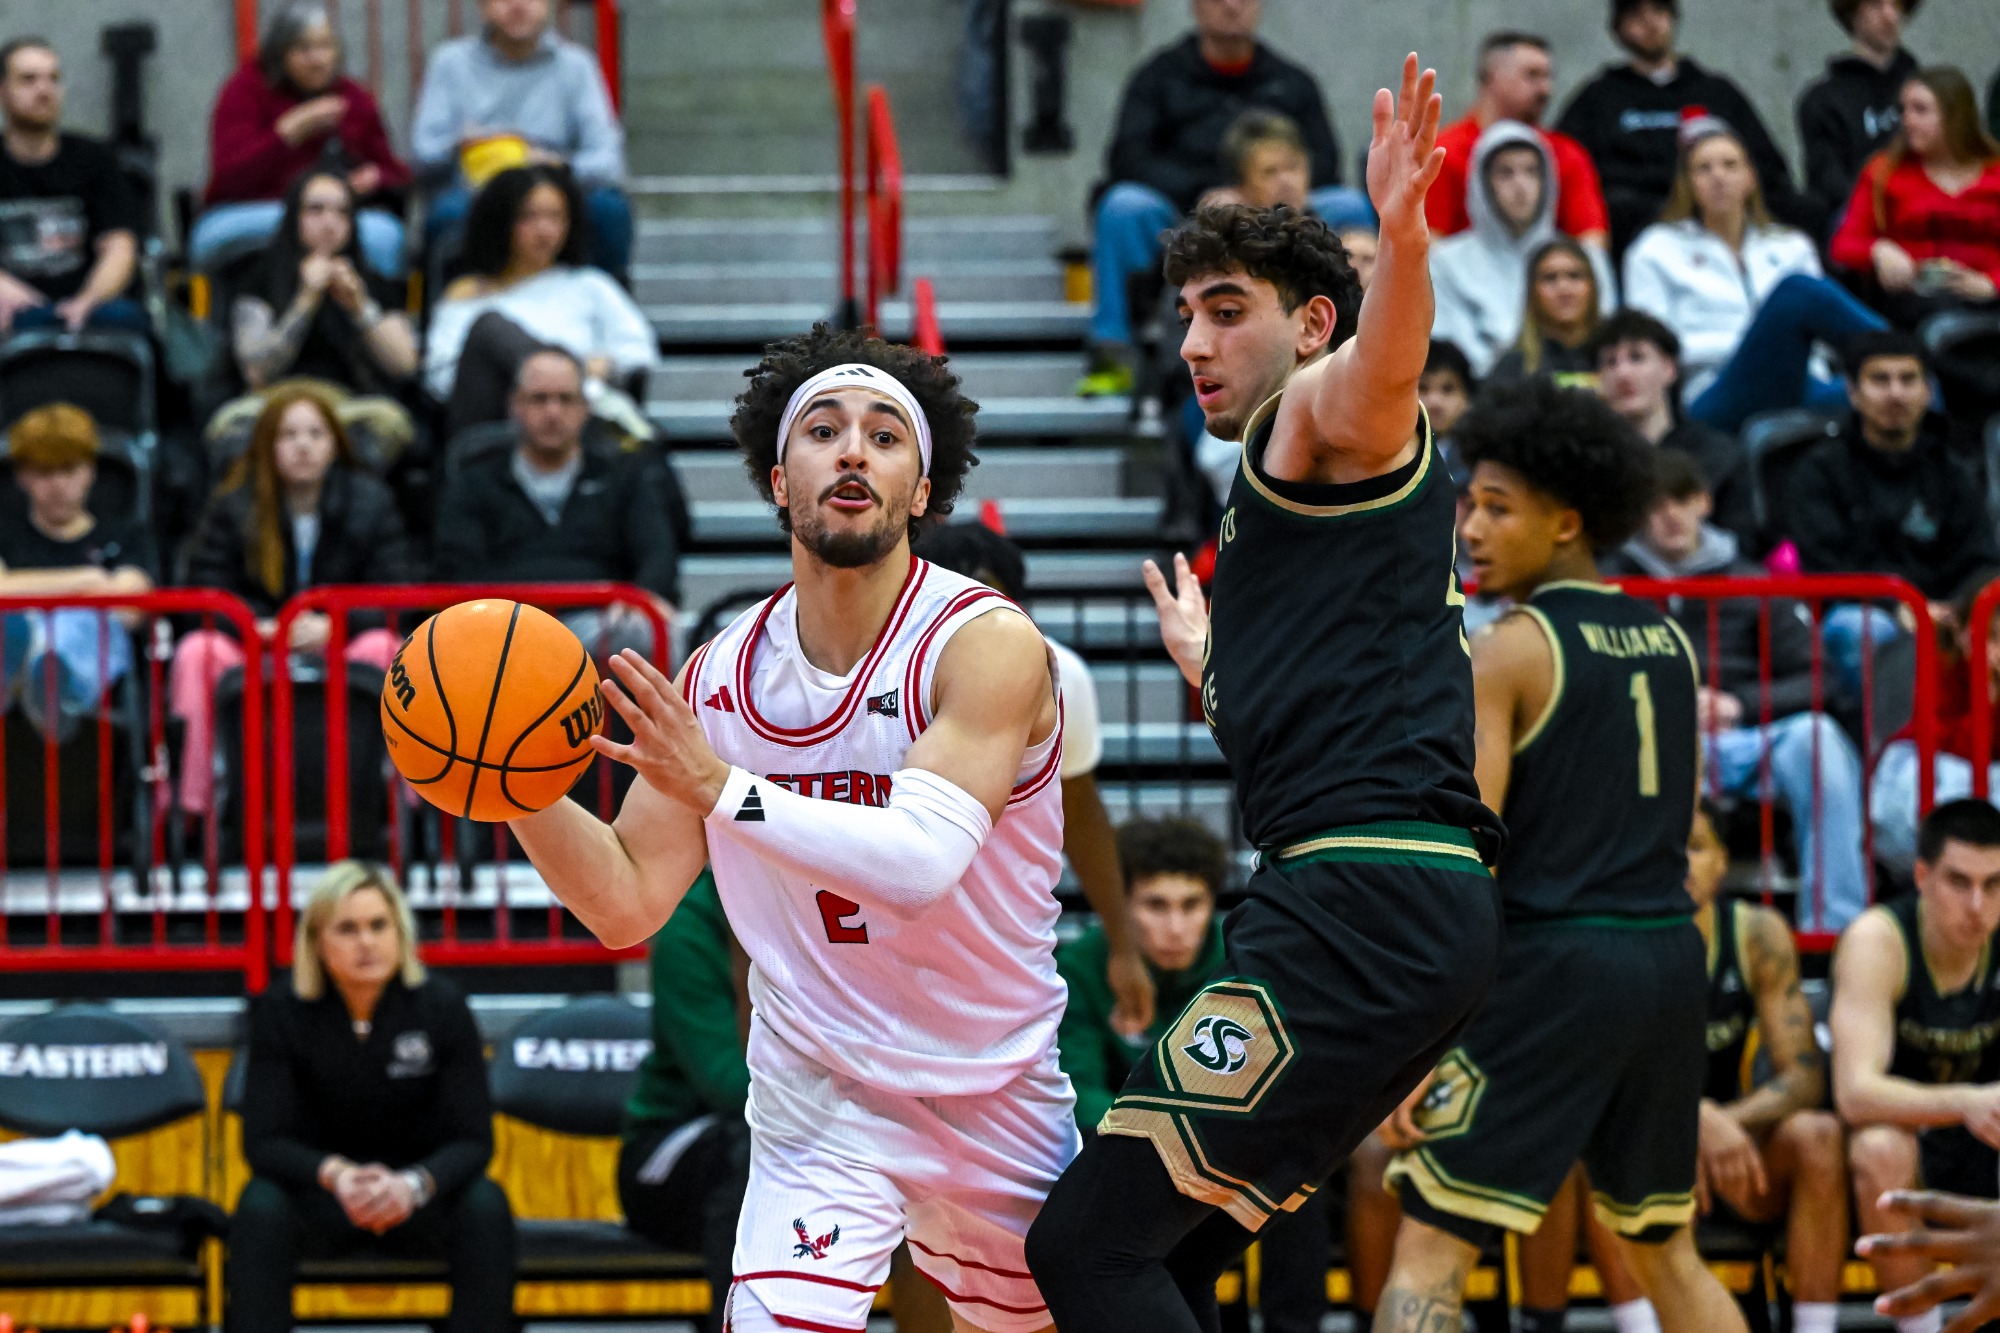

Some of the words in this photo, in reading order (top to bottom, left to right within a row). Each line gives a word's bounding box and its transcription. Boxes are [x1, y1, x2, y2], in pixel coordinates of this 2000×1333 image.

[1578, 622, 1679, 658] WILLIAMS
[560, 682, 603, 748] Wil
[881, 691, 896, 710] SKY
[1629, 670, 1660, 797] 1
[764, 770, 893, 808] STERN
[815, 889, 869, 944] 2
[0, 1041, 168, 1078] EASTERN
[513, 1037, 655, 1071] EASTE
